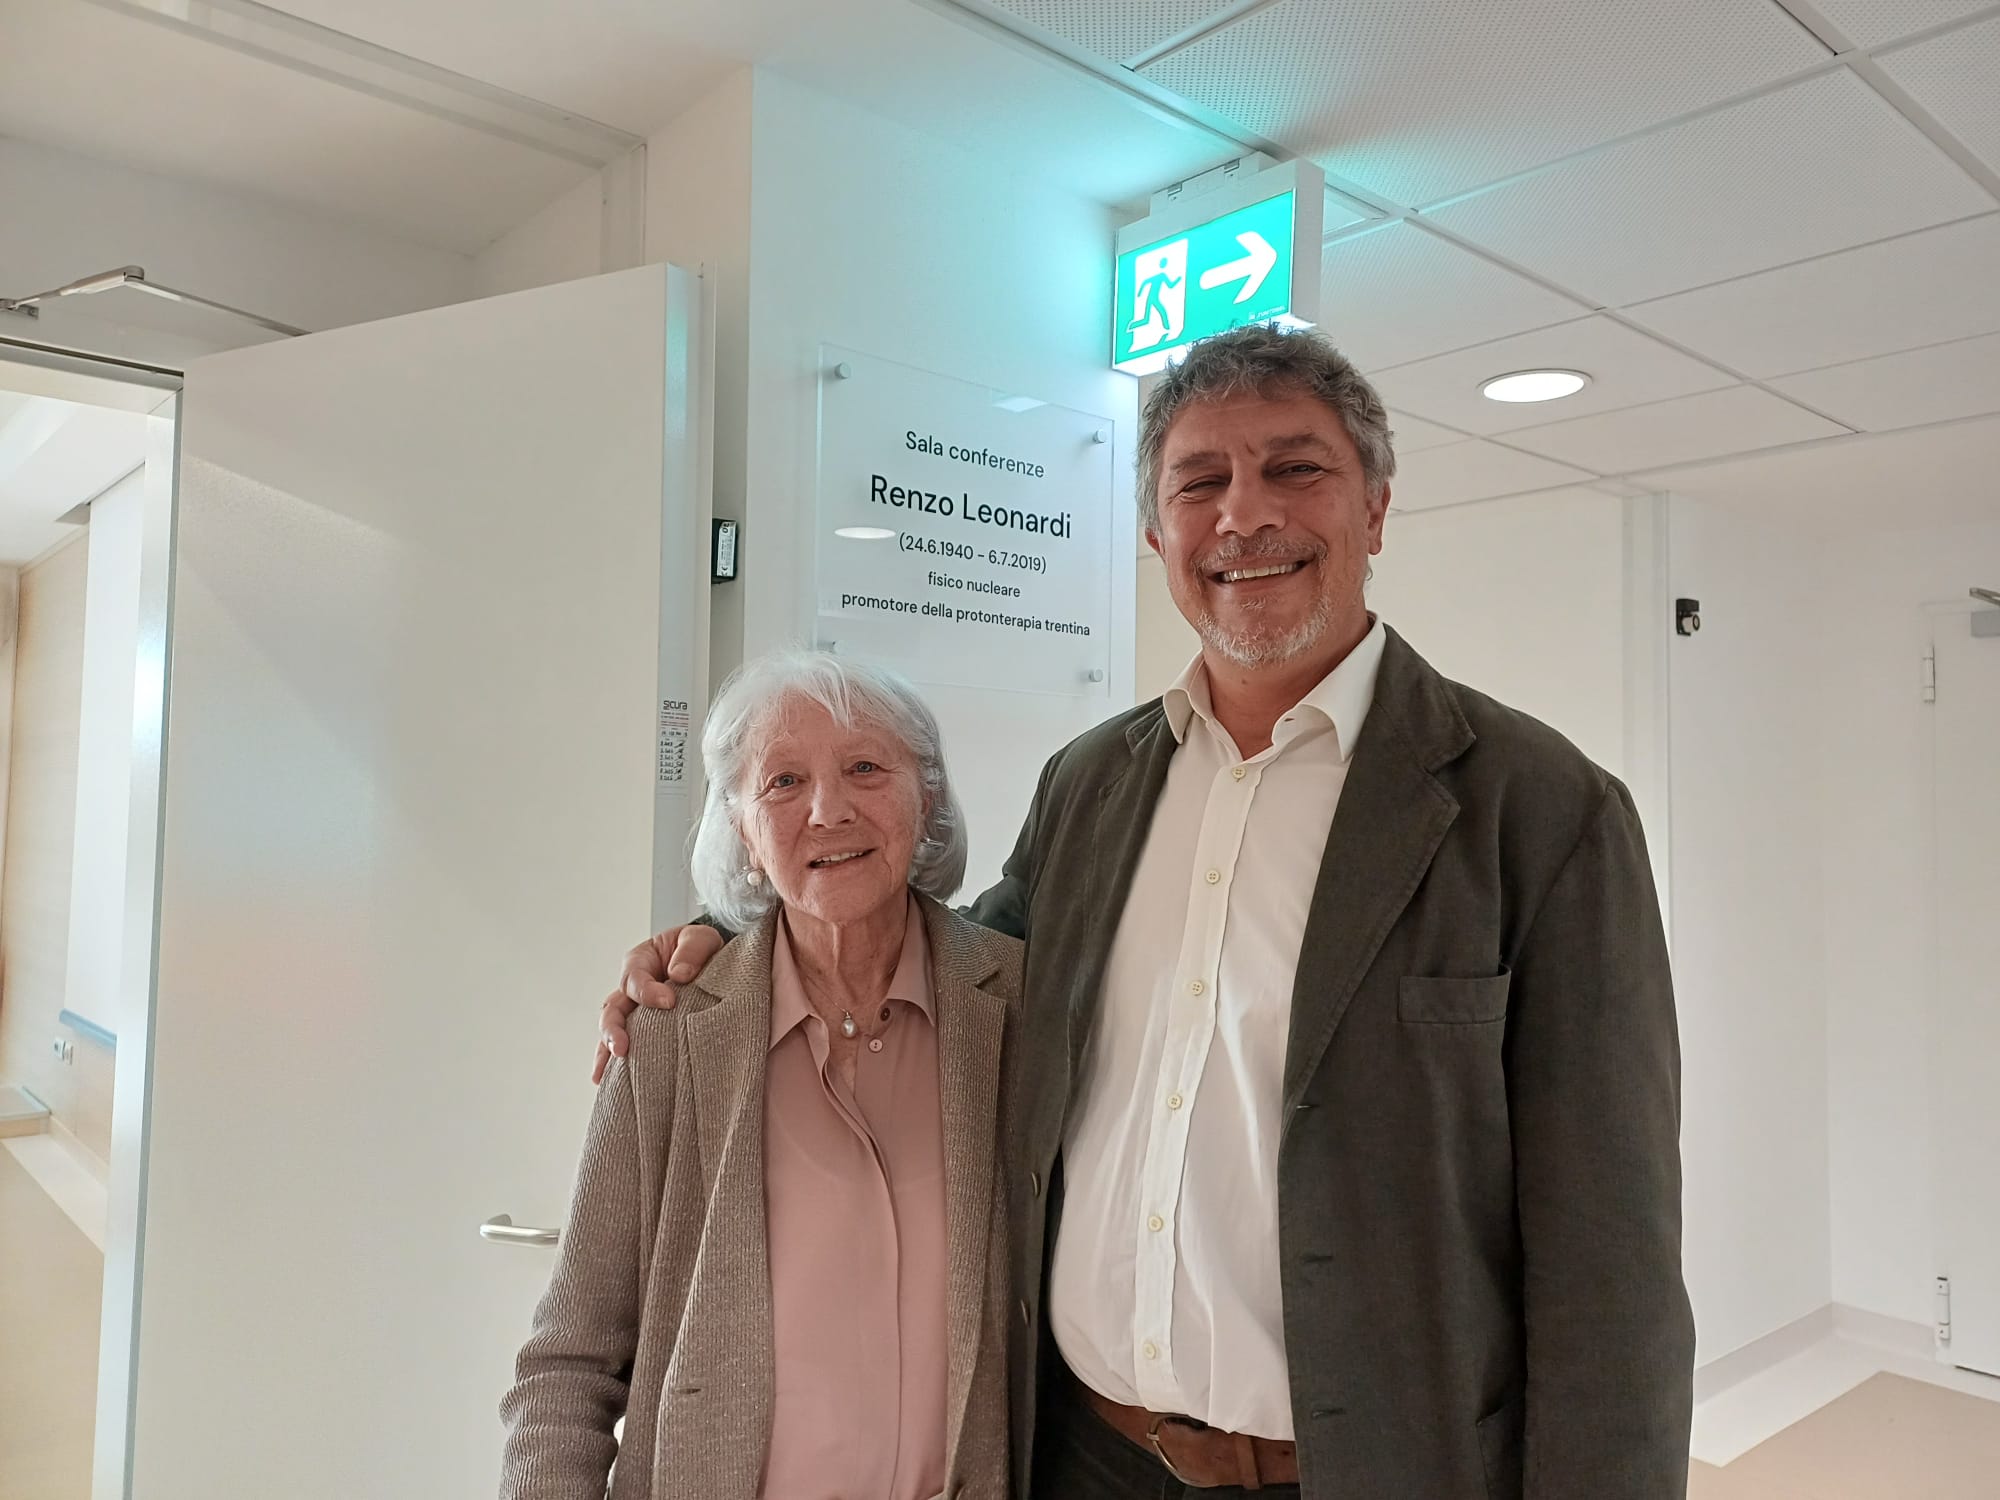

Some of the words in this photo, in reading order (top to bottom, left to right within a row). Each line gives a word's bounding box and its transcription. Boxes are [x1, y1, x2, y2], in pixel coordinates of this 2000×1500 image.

[905, 430, 944, 457] Sala
[948, 446, 1045, 479] conferenze
[870, 473, 954, 517] Renzo
[962, 492, 1071, 540] Leonardi
[899, 531, 974, 561] (24.6.1940
[988, 549, 1047, 575] 6.7.2019)
[927, 570, 964, 590] fisico
[966, 579, 1021, 598] nucleare
[841, 593, 918, 614] promotore
[921, 600, 953, 619] della
[955, 608, 1042, 633] protonterapia
[1044, 618, 1091, 637] trentina
